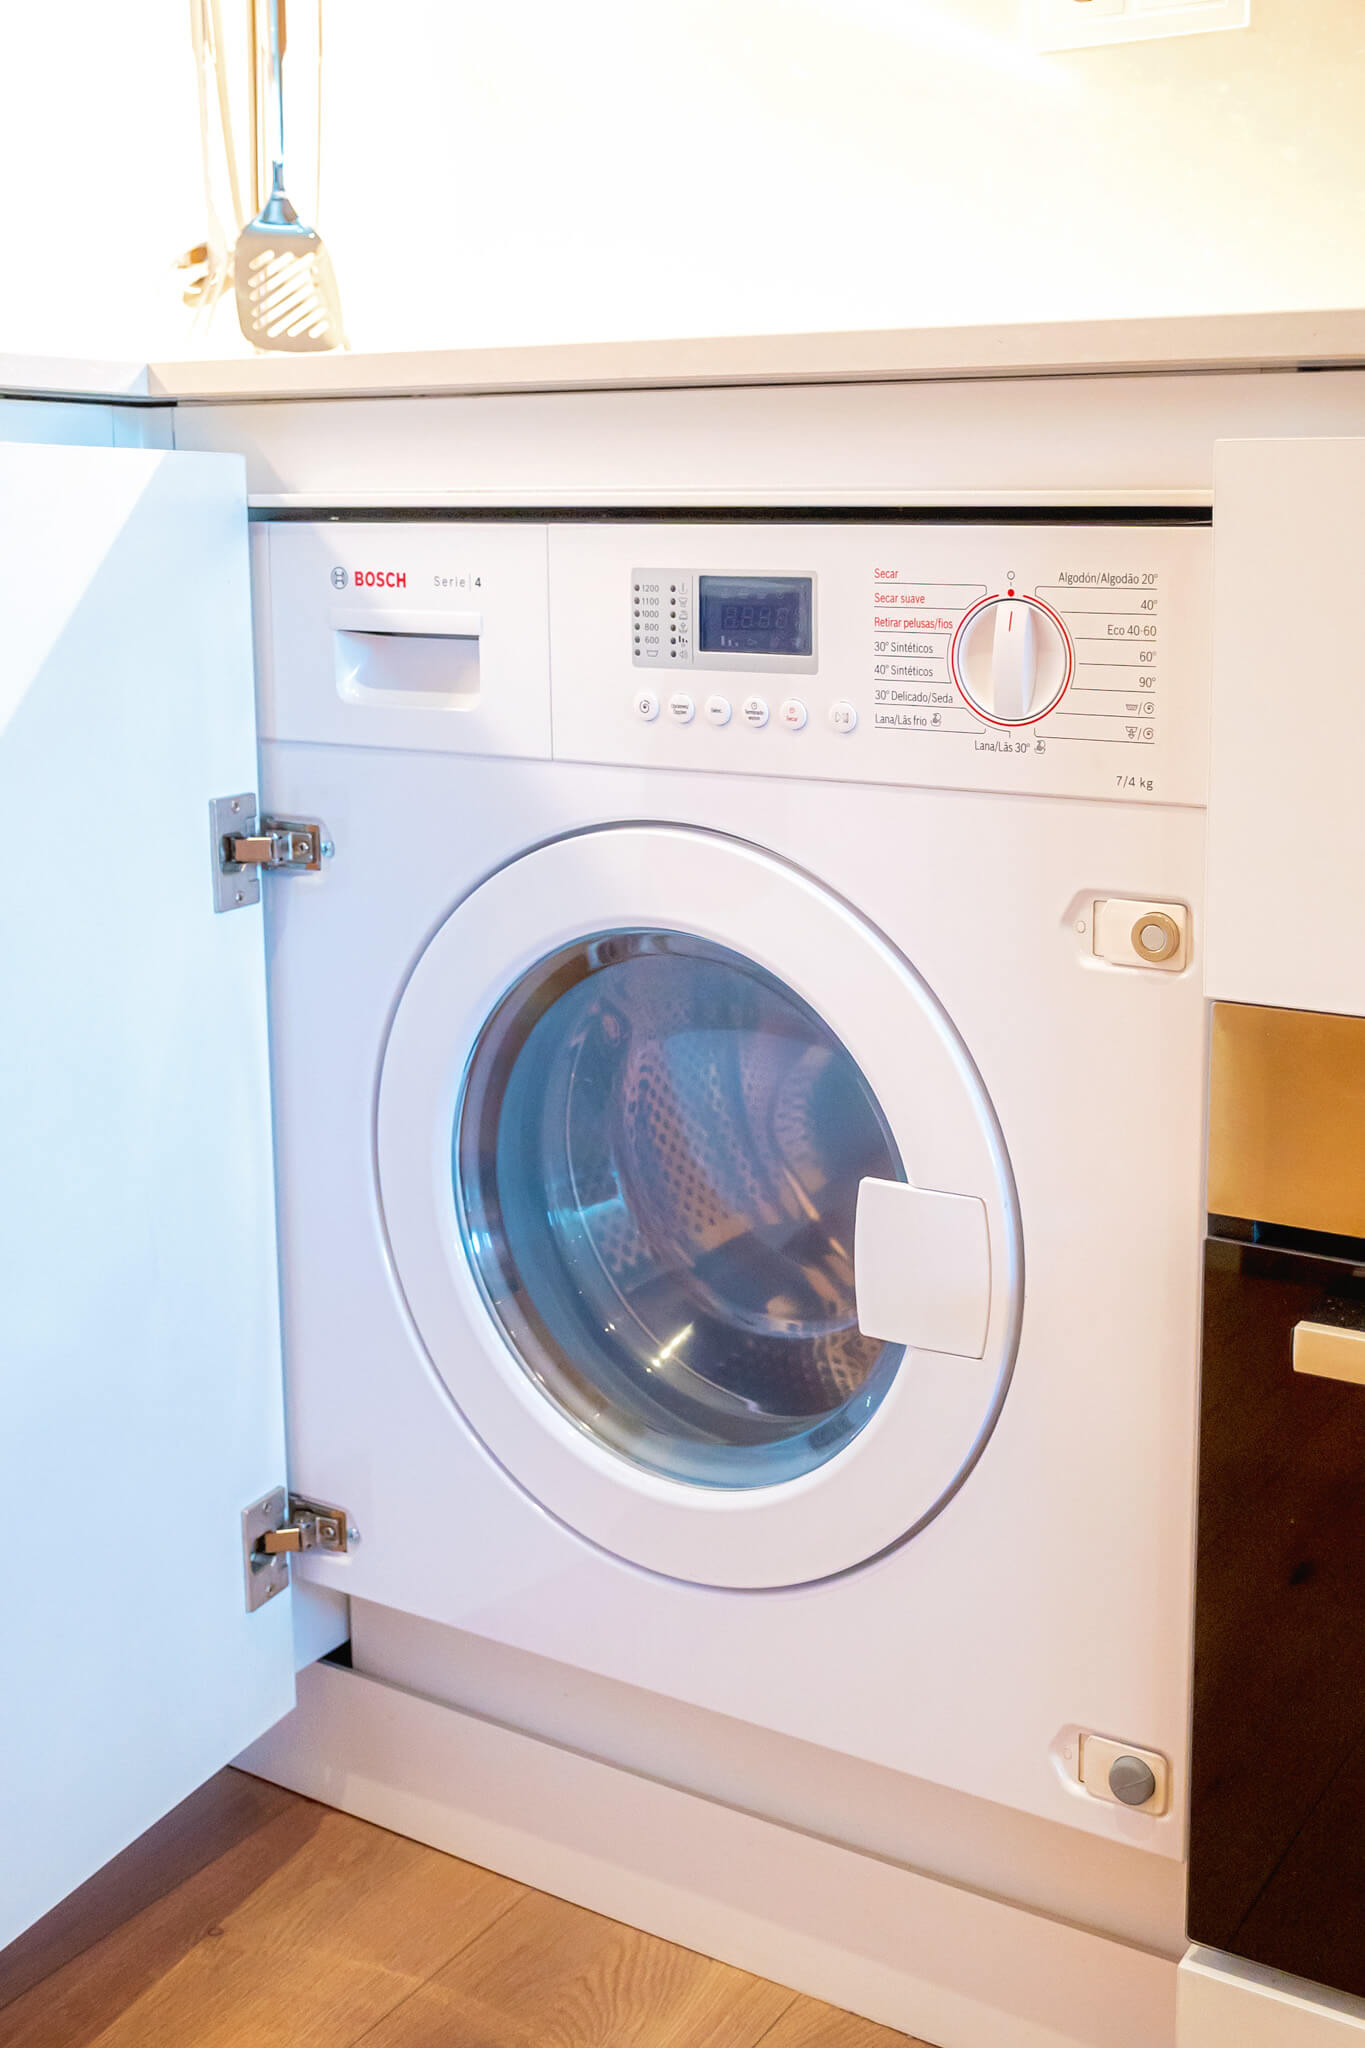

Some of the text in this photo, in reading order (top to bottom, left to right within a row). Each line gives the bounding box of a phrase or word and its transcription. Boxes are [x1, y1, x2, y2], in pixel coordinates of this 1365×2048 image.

[354, 571, 406, 588] BOSCH
[874, 568, 898, 579] Secar
[1059, 572, 1140, 586] Algodón/Algodão
[434, 575, 482, 588] Serie 4
[642, 584, 660, 593] 1200
[641, 597, 660, 606] 1100
[874, 592, 926, 604] Secar suave
[641, 610, 660, 618] 1000
[644, 623, 660, 631] 800
[874, 616, 954, 630] Retirar pelusas/fios
[1107, 624, 1157, 637] Eco 40-60
[644, 636, 660, 644] 600
[891, 642, 934, 654] Sintéticos
[891, 665, 934, 677] Sintéticos
[891, 690, 954, 704] Delicado/Seda
[913, 714, 928, 726] frio
[1116, 775, 1154, 791] 7/4 kg
